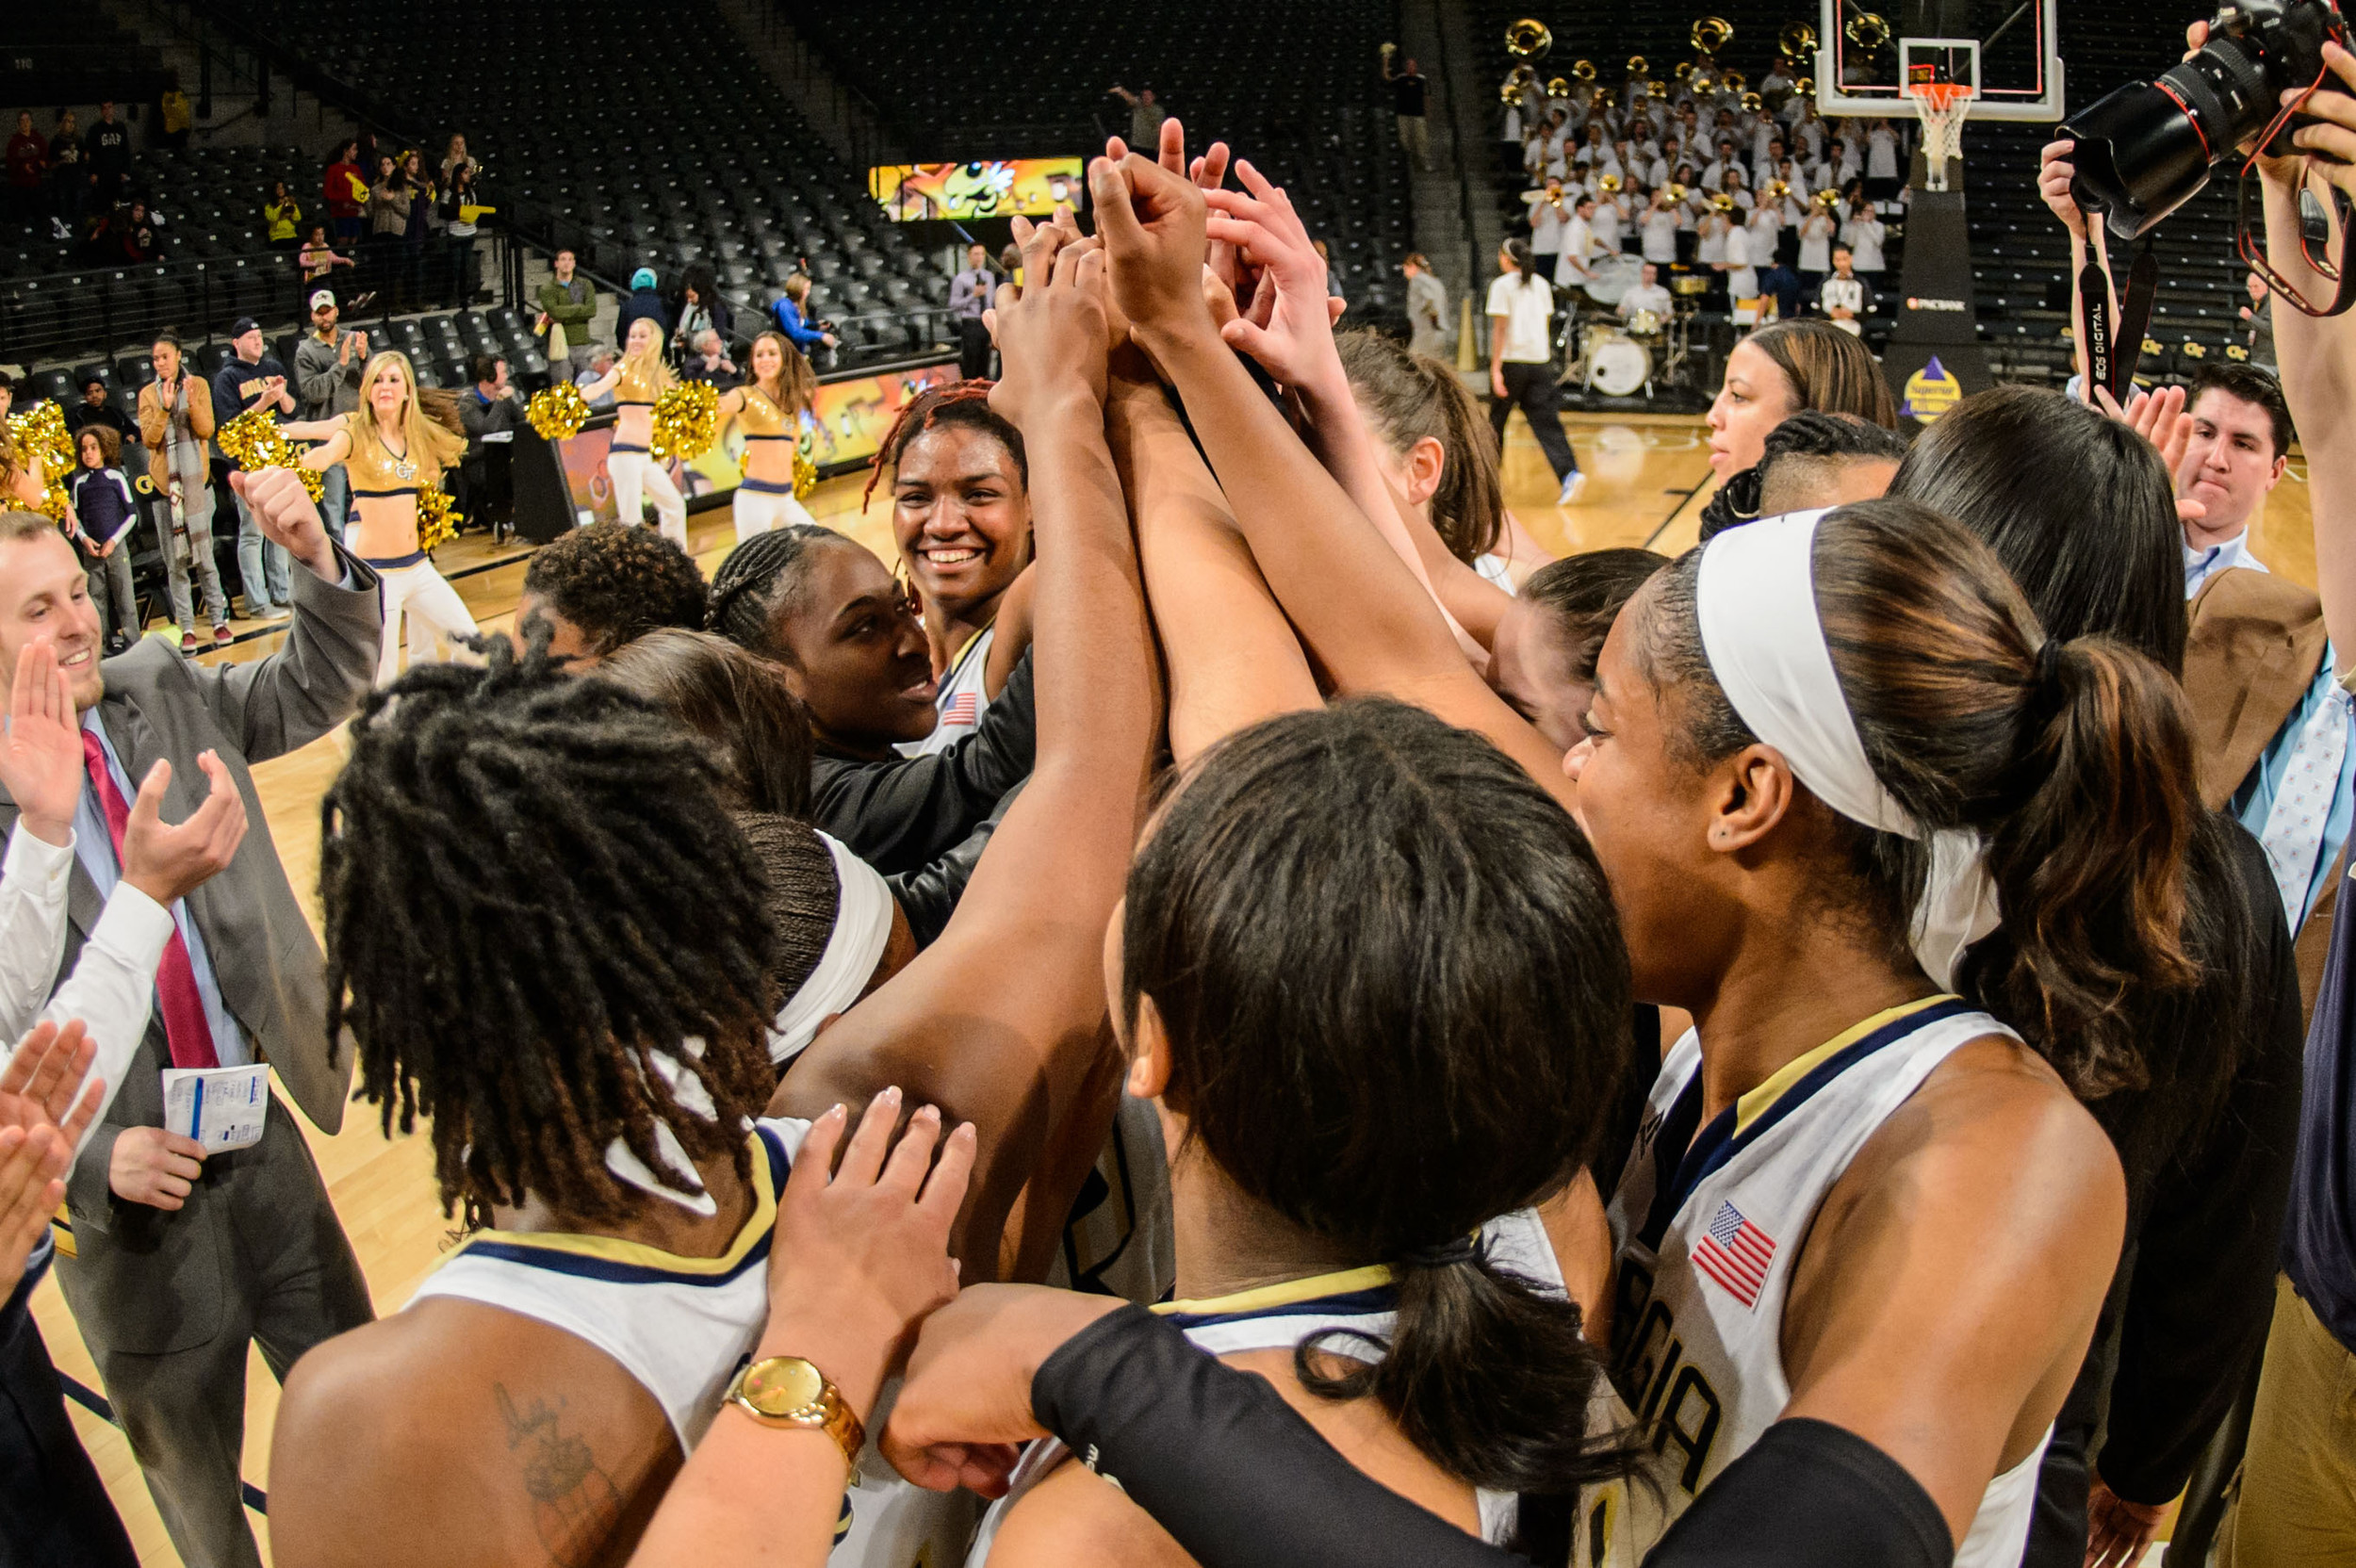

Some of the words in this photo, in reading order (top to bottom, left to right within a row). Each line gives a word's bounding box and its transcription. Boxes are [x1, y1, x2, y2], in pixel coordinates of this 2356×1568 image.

[2092, 302, 2105, 354] DIGITAL
[2095, 355, 2106, 381] EOS
[135, 474, 155, 495] G
[396, 465, 417, 482] GT
[1611, 1256, 1720, 1496] RGIA
